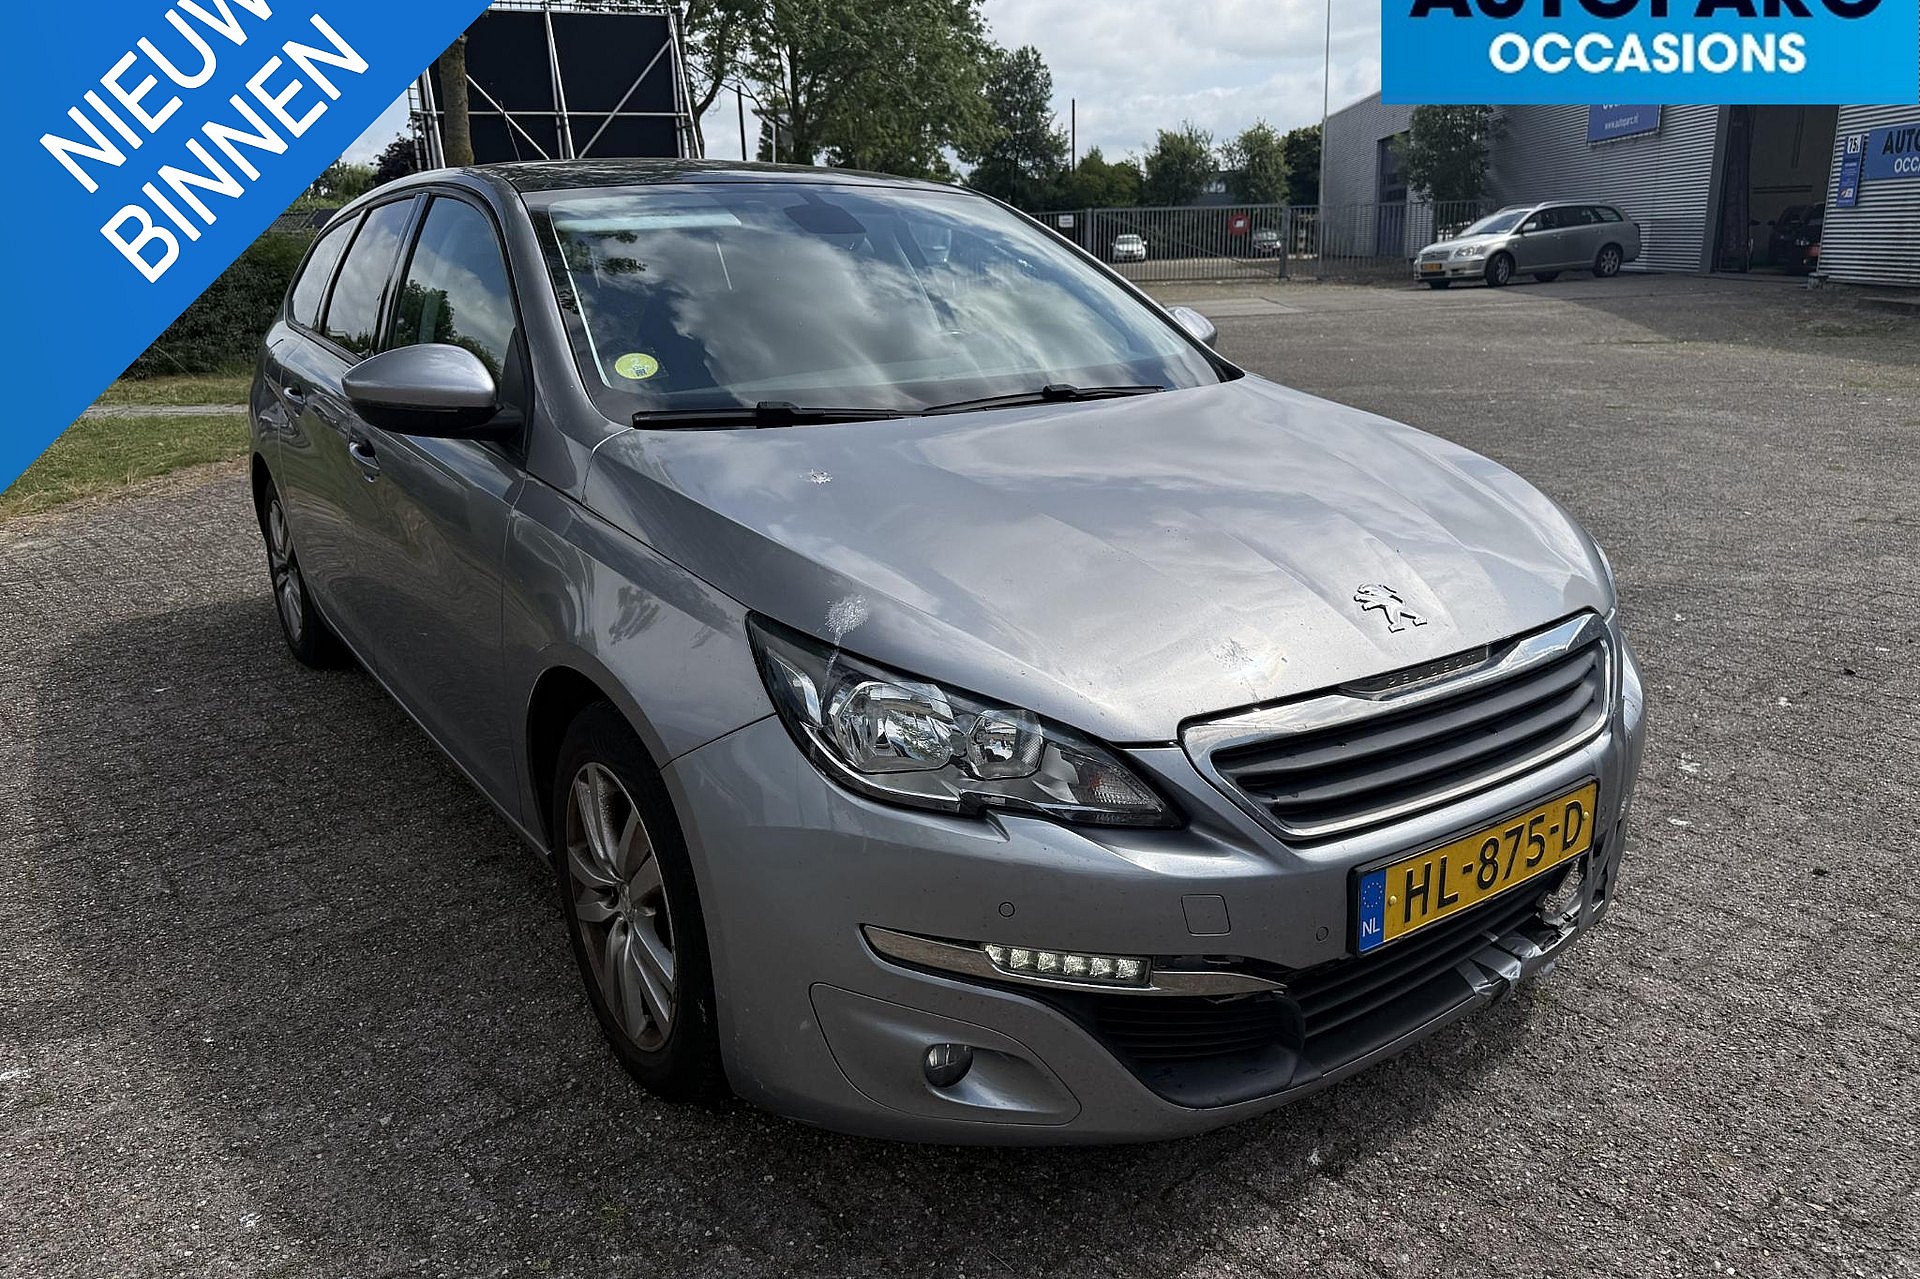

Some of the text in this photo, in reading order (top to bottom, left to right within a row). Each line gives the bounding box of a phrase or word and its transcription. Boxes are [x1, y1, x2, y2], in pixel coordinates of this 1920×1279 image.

[1894, 155, 1920, 174] OCC
[1403, 799, 1583, 923] HL-875-D
[1361, 917, 1381, 938] NL
